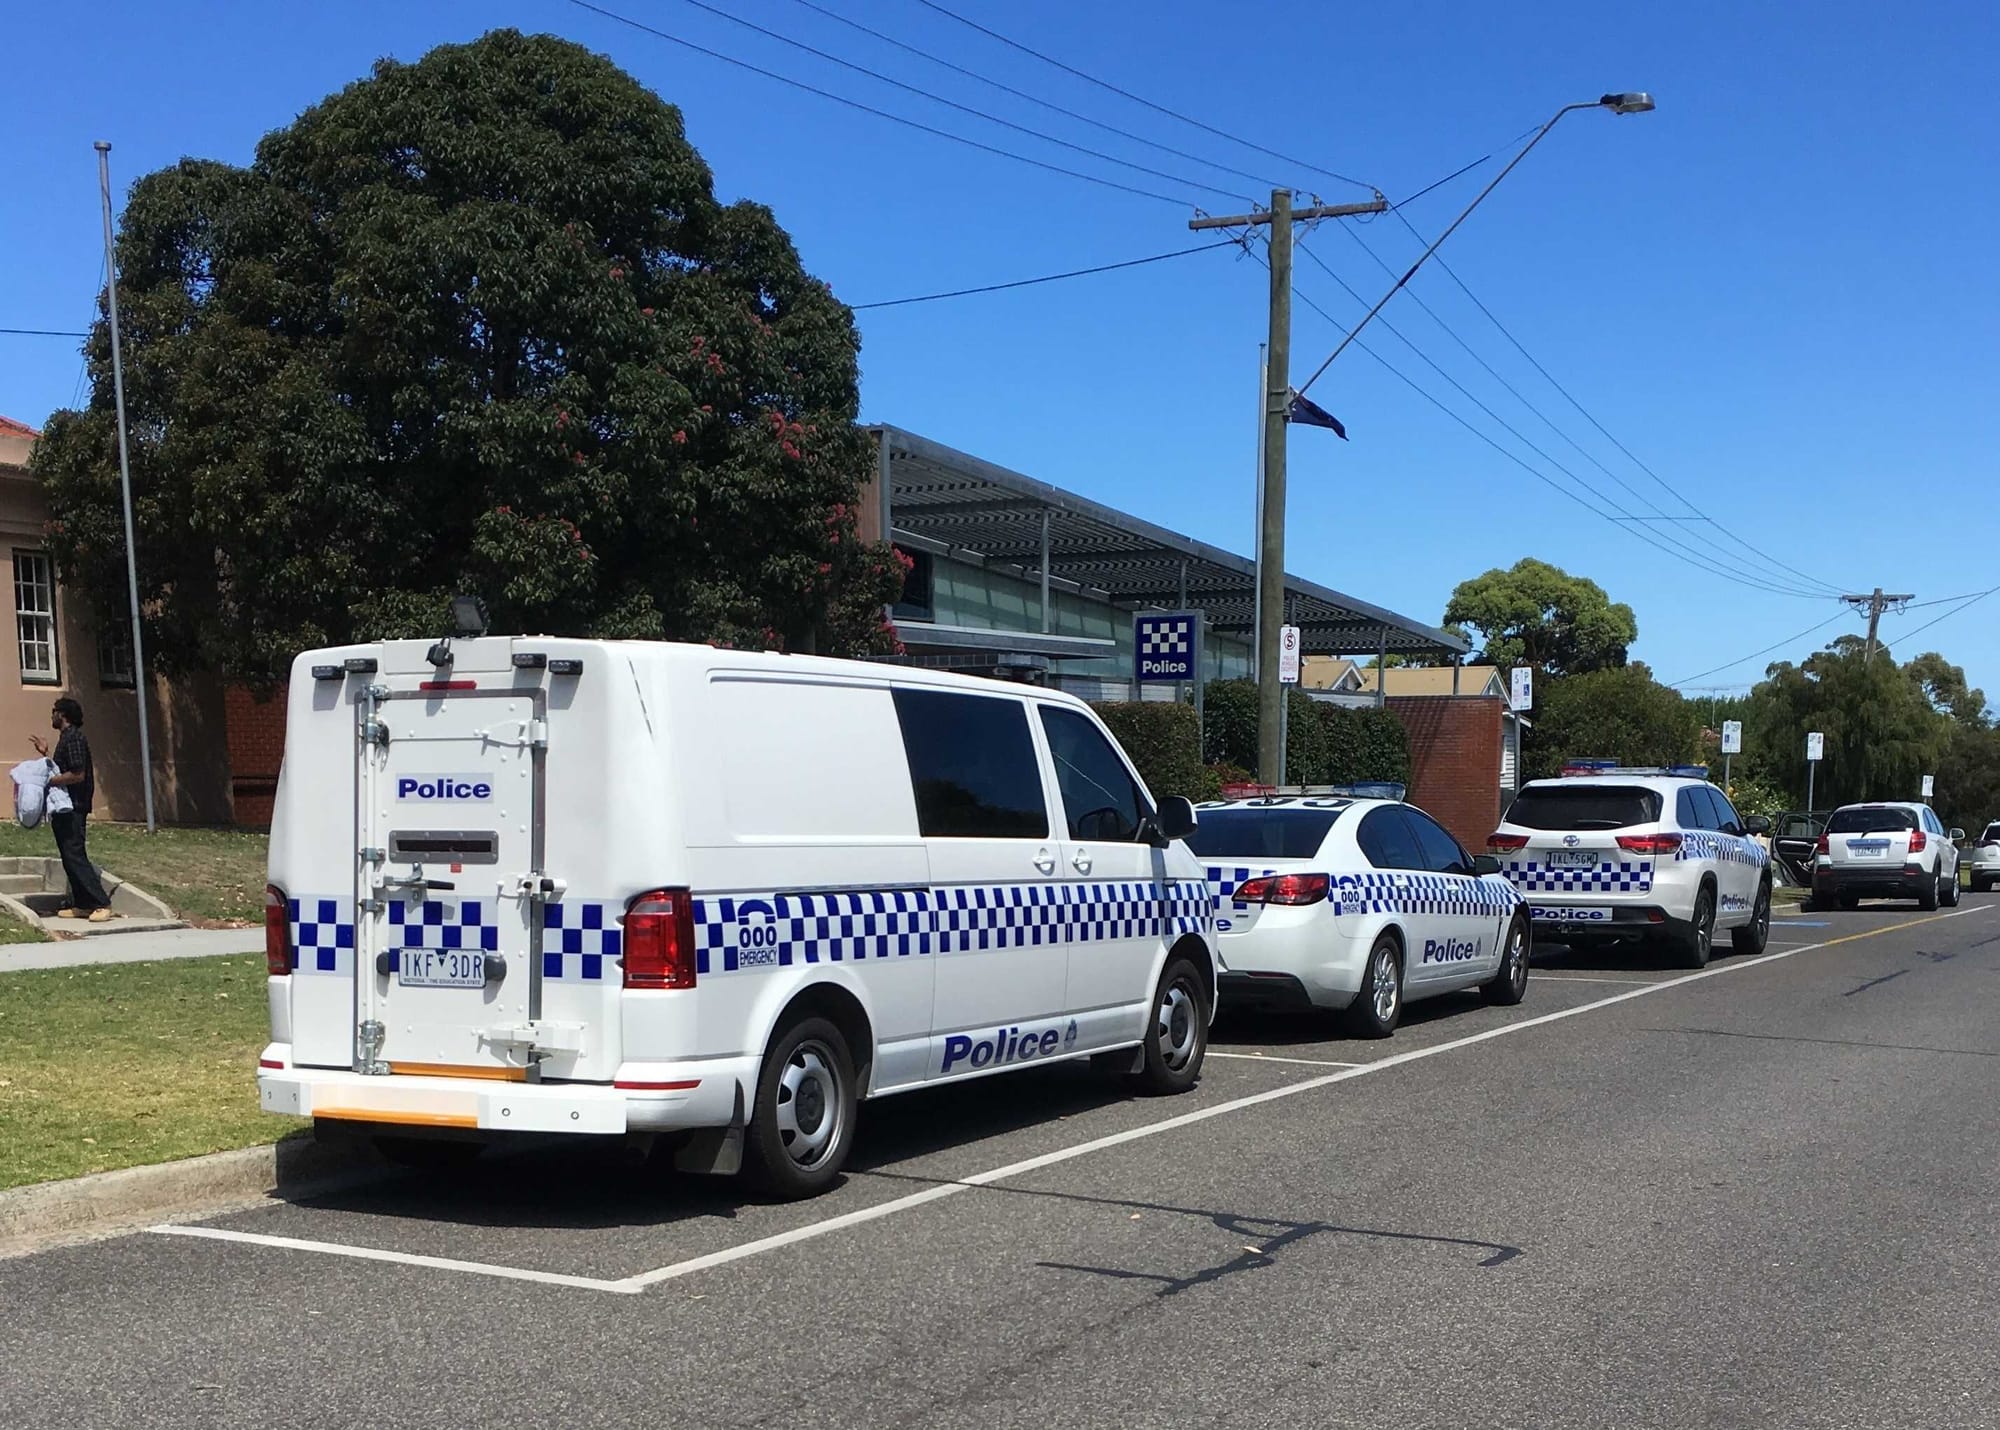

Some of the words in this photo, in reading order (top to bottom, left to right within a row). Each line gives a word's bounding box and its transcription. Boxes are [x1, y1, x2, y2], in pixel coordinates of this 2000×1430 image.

[1142, 660, 1187, 674] Police
[399, 778, 491, 799] Police
[1341, 890, 1360, 903] 000
[1721, 894, 1746, 910] Police
[1530, 907, 1604, 920] Police
[739, 925, 777, 949] 000
[1423, 938, 1474, 964] Police
[405, 953, 434, 977] 1KF
[449, 955, 482, 979] 3DR
[941, 1026, 1059, 1073] Police
